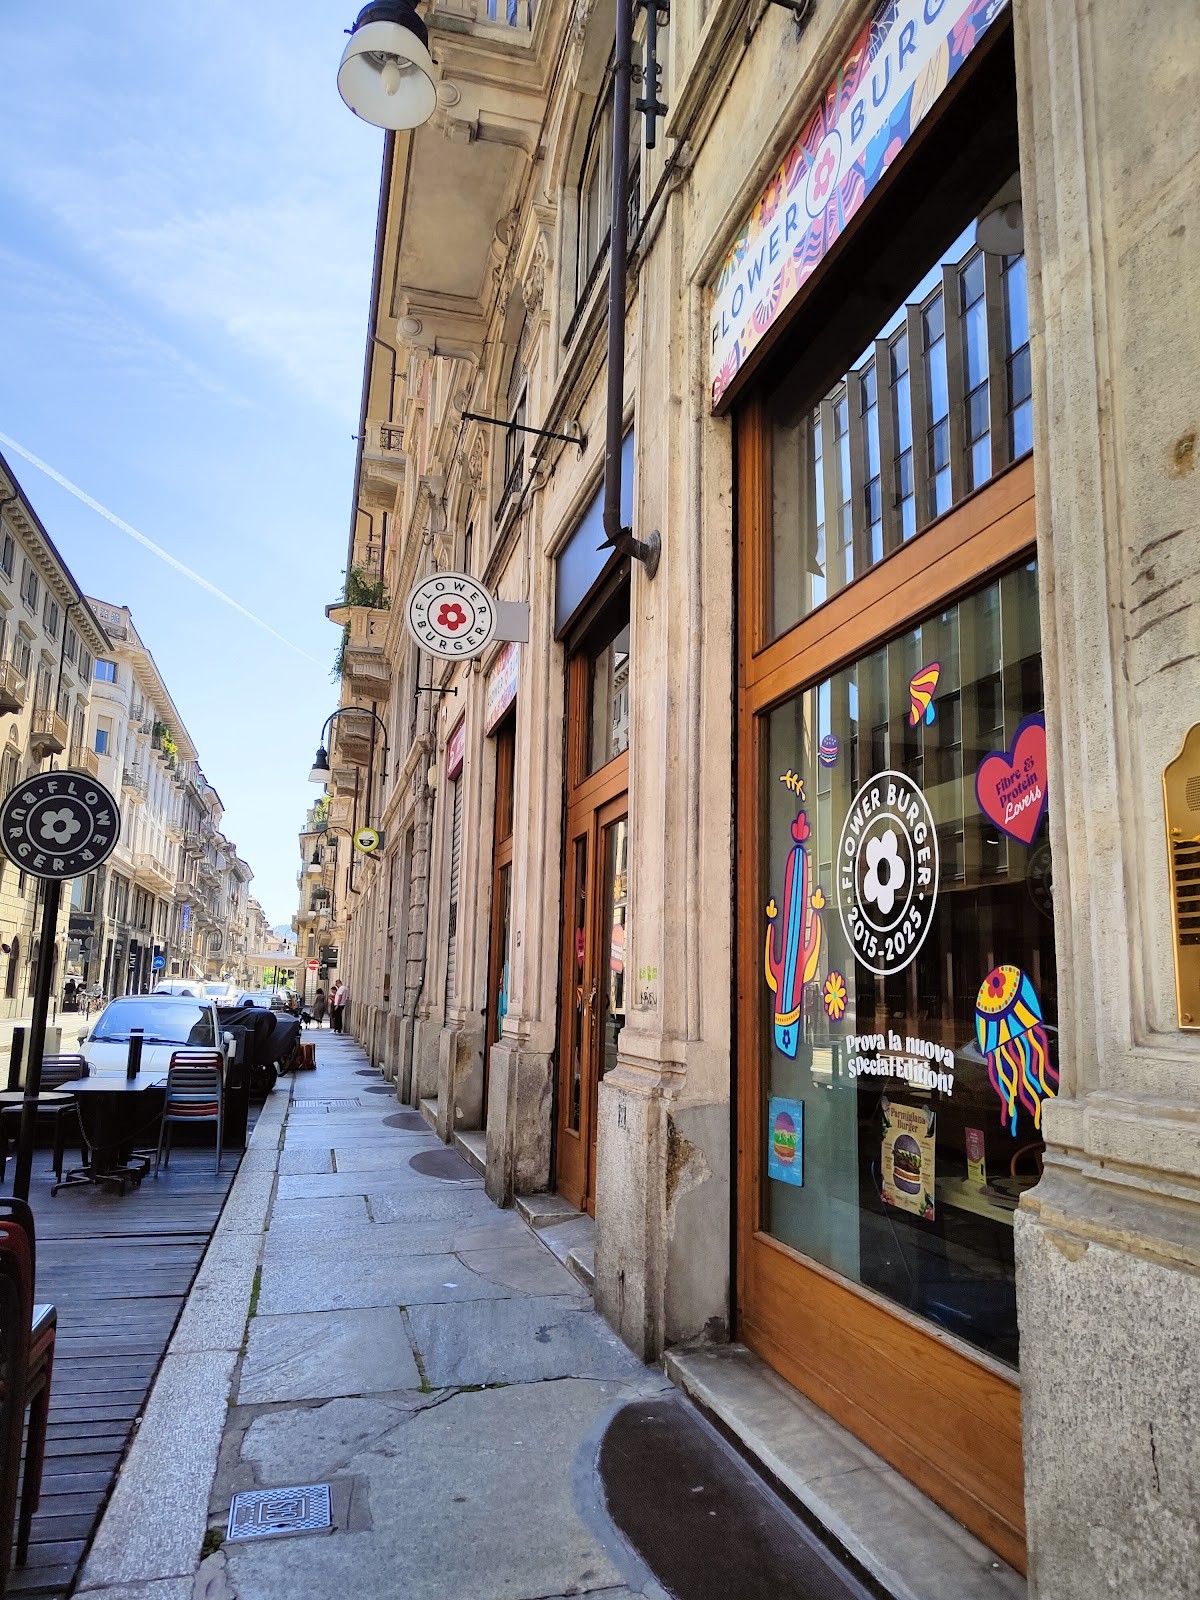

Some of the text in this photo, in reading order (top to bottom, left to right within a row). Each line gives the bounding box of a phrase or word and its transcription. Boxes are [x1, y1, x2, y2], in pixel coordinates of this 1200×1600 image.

[712, 202, 798, 354] FLOWER
[415, 581, 487, 650] FLOWER BURGER
[995, 769, 1021, 796] Fibre
[999, 771, 1039, 809] Protein
[1004, 784, 1042, 825] Lovers
[9, 781, 111, 872] FLOWER BURGER
[842, 787, 881, 889] FLOWER
[886, 783, 931, 885] BURGER
[848, 904, 922, 961] 2015-2025
[887, 1029, 903, 1052] la
[905, 1036, 955, 1069] nuova
[897, 1119, 919, 1133] Burger
